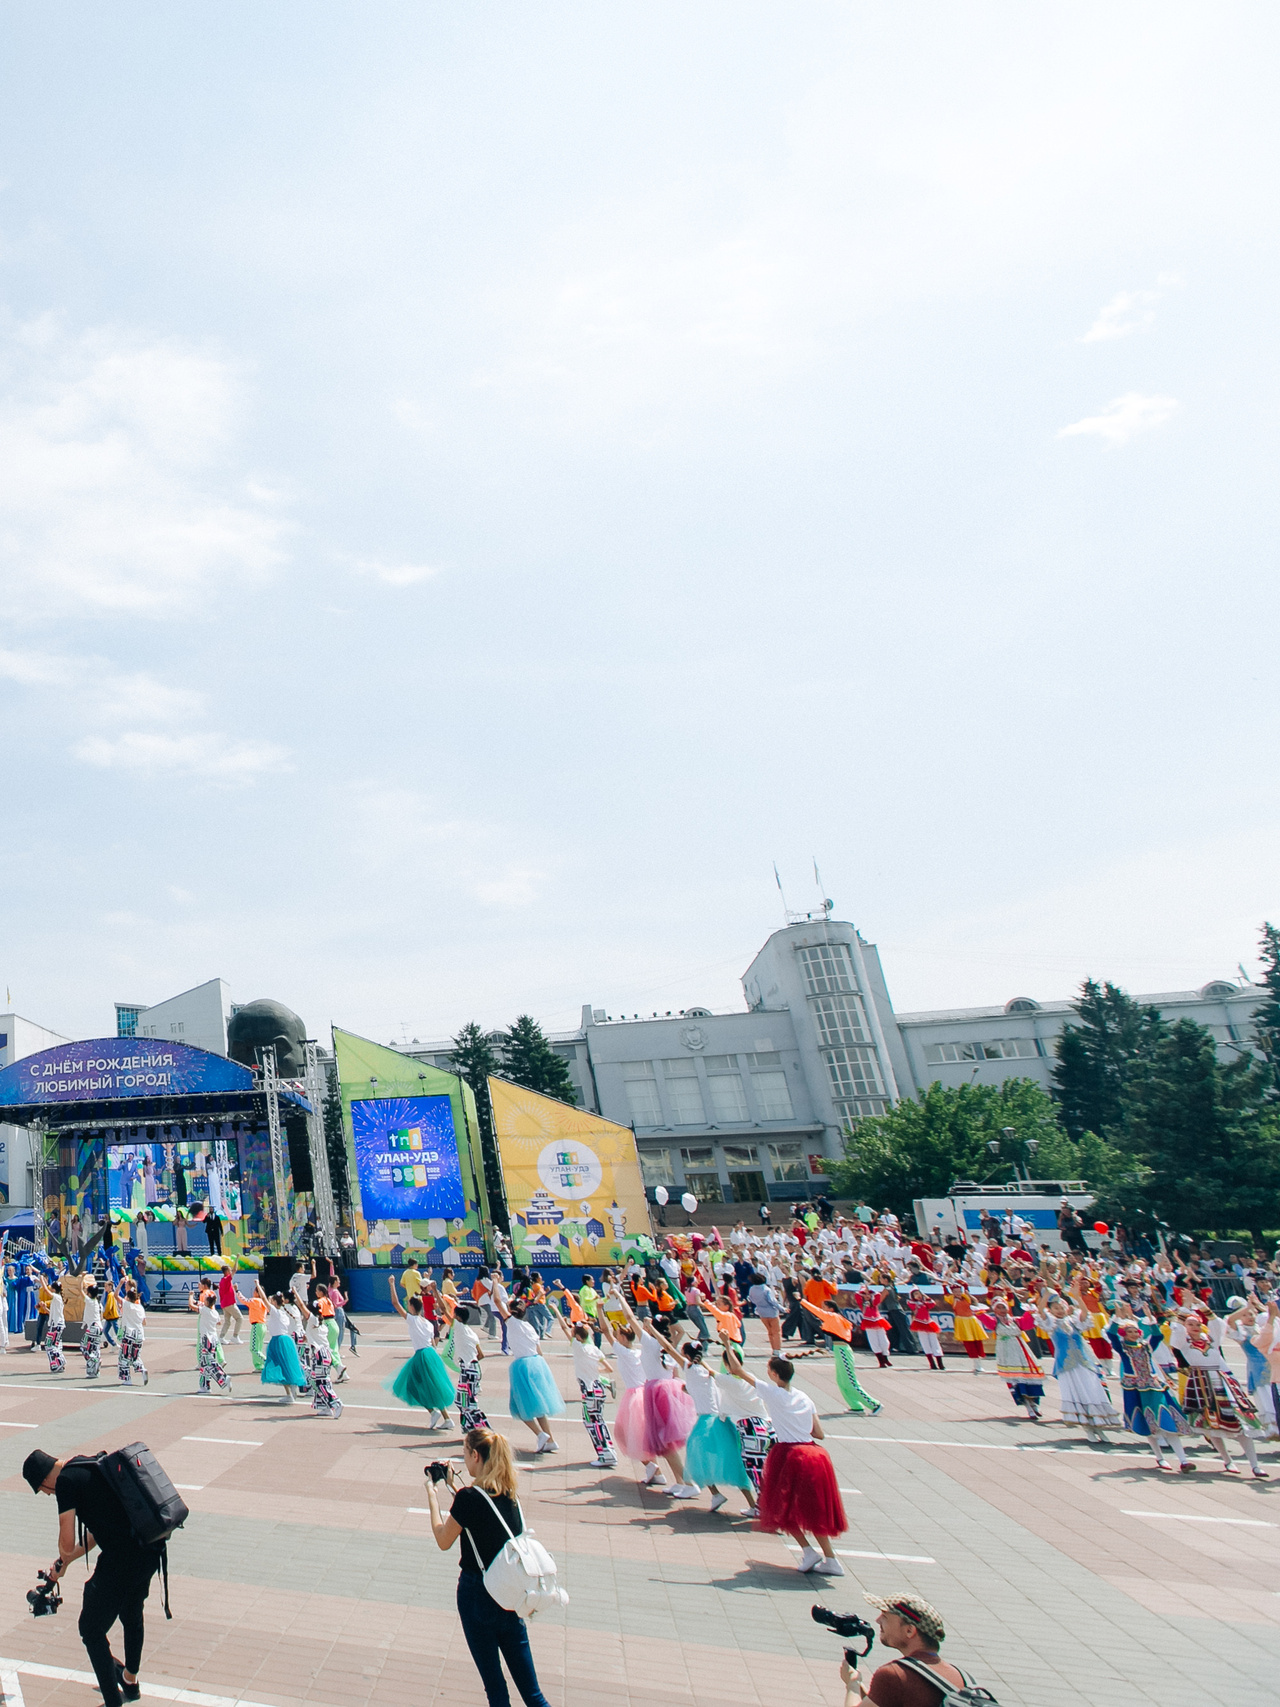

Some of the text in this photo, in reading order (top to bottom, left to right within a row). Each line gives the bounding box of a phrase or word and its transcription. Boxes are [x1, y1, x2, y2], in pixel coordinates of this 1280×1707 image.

[30, 1054, 177, 1077] С ДНЁМ РОЖДЕНИЯ,
[34, 1073, 171, 1094] ЛЮБИМЫЙ ГОРОД!
[375, 1151, 439, 1164] УЛАН-УДЭ
